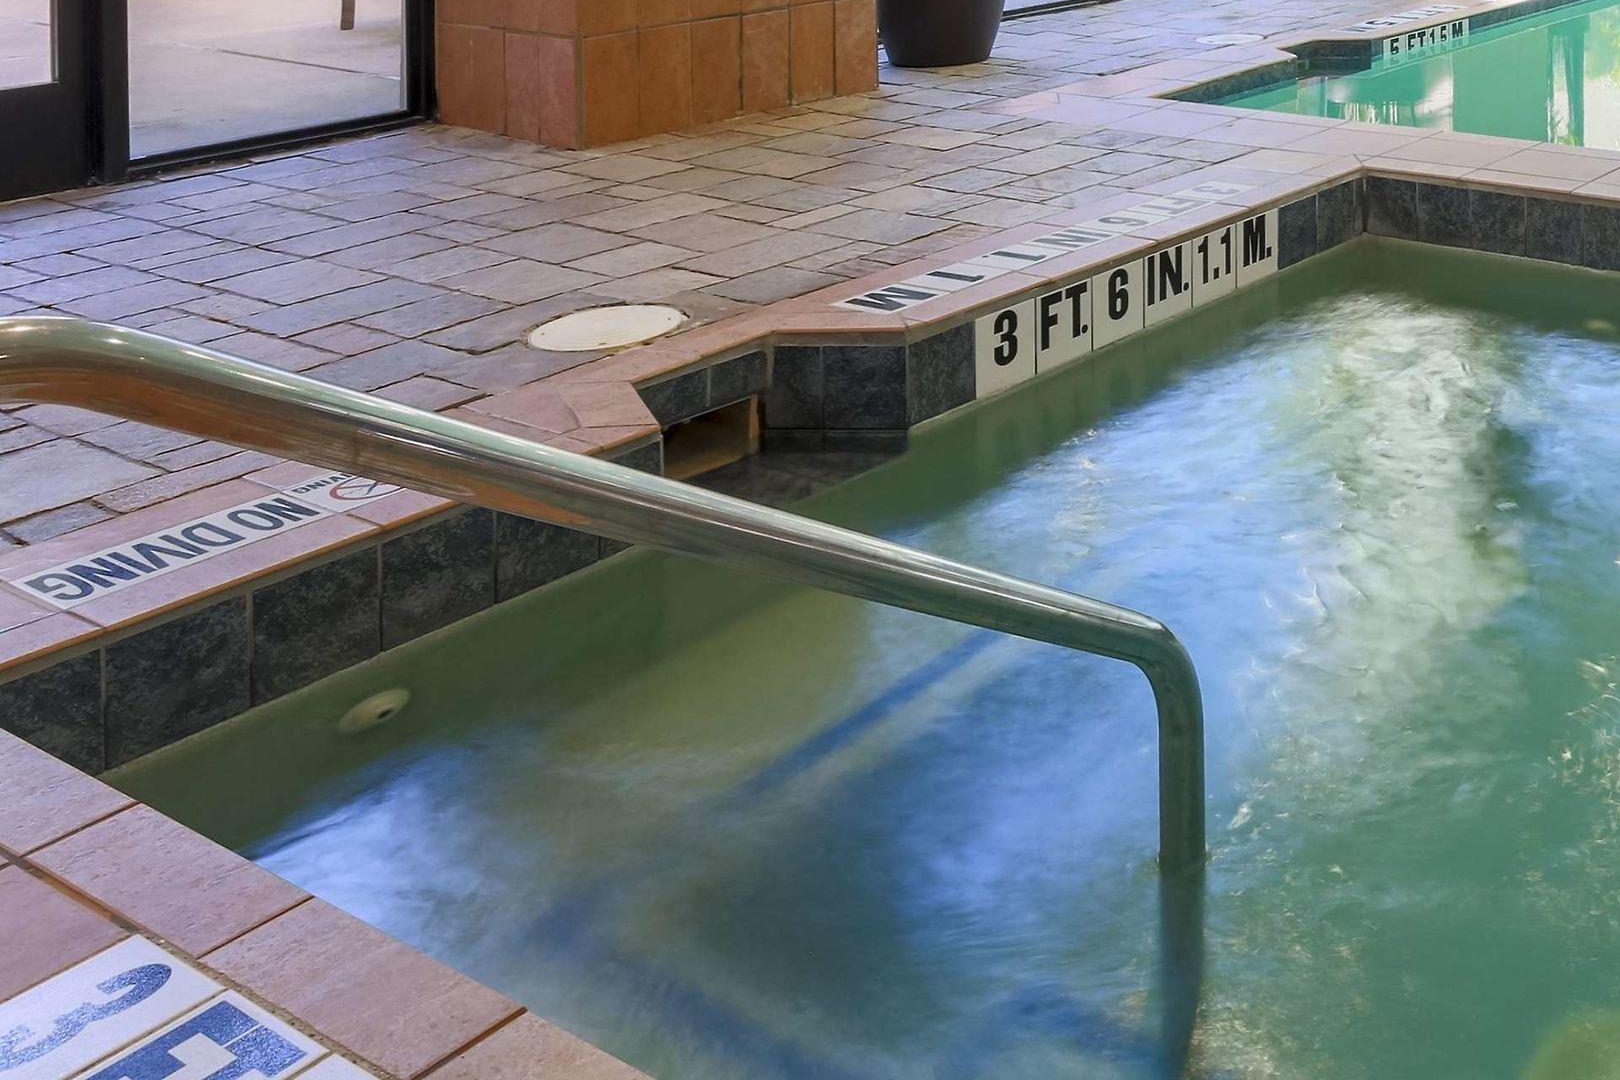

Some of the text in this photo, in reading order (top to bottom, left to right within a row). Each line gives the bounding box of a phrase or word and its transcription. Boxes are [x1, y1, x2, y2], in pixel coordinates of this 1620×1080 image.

[1390, 38, 1399, 55] 5
[1408, 31, 1426, 51] FT
[1452, 21, 1463, 38] M
[1034, 229, 1113, 248] IN
[844, 286, 937, 315] M
[993, 309, 1018, 367] 3
[1040, 280, 1090, 352] FT.
[1107, 268, 1130, 321] 6
[1146, 245, 1190, 307] IN.
[1242, 214, 1273, 268] M.
[24, 497, 321, 601] NO DIVING
